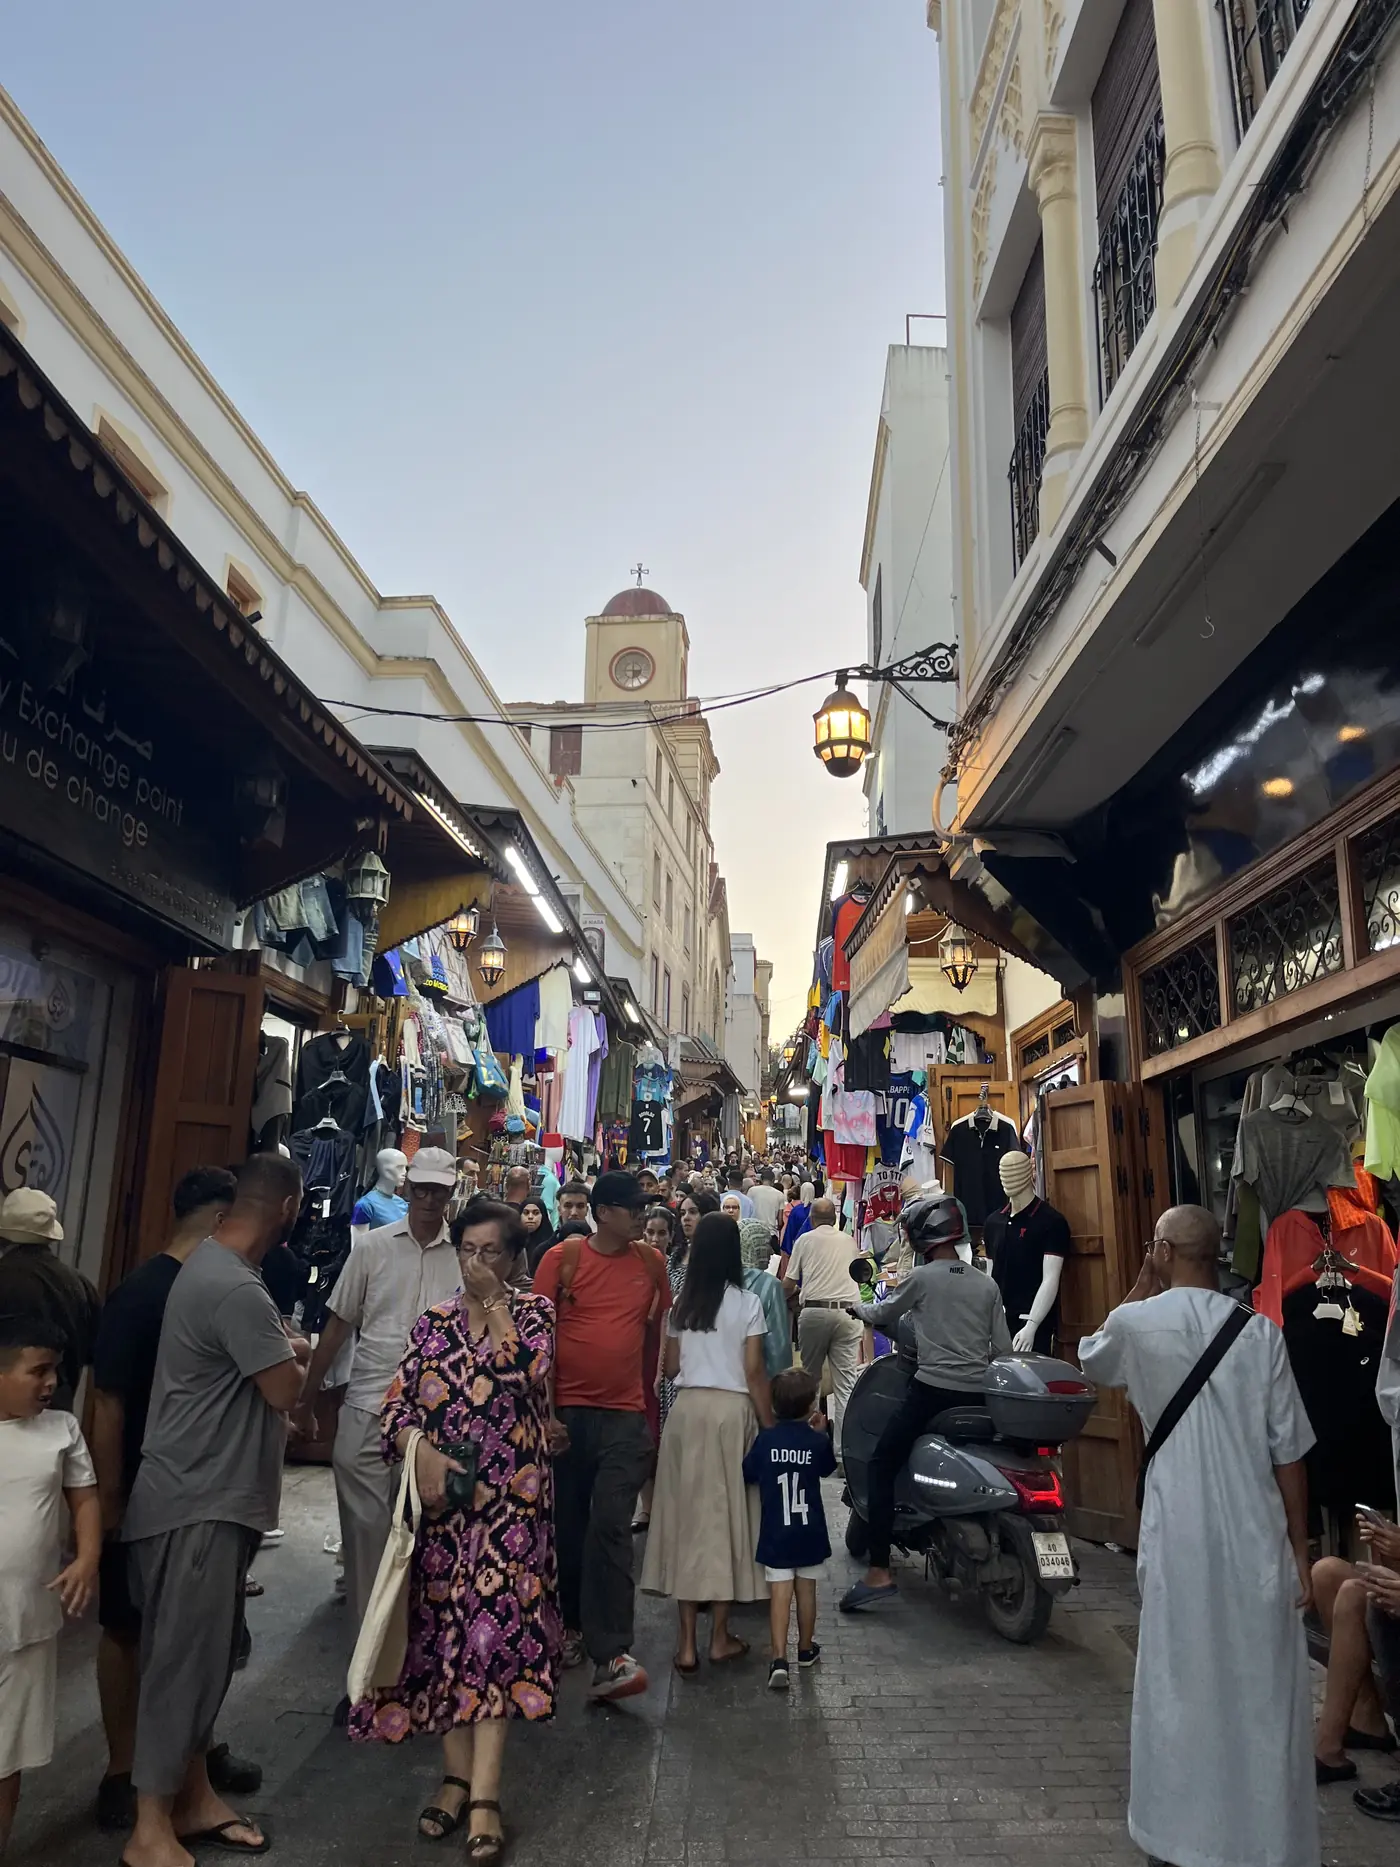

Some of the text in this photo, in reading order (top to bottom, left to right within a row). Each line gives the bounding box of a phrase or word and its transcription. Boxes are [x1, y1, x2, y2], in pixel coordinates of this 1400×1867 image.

[18, 680, 131, 789] Exchange
[136, 775, 184, 827] point
[26, 746, 60, 790] de
[66, 774, 149, 847] change
[887, 1085, 911, 1094] BAPPE
[885, 1098, 910, 1128] 10
[643, 1117, 651, 1132] 7
[949, 1266, 965, 1275] NIKE
[770, 1448, 813, 1465] D.DOUÉ
[777, 1471, 809, 1526] 14
[1047, 1543, 1057, 1553] 40
